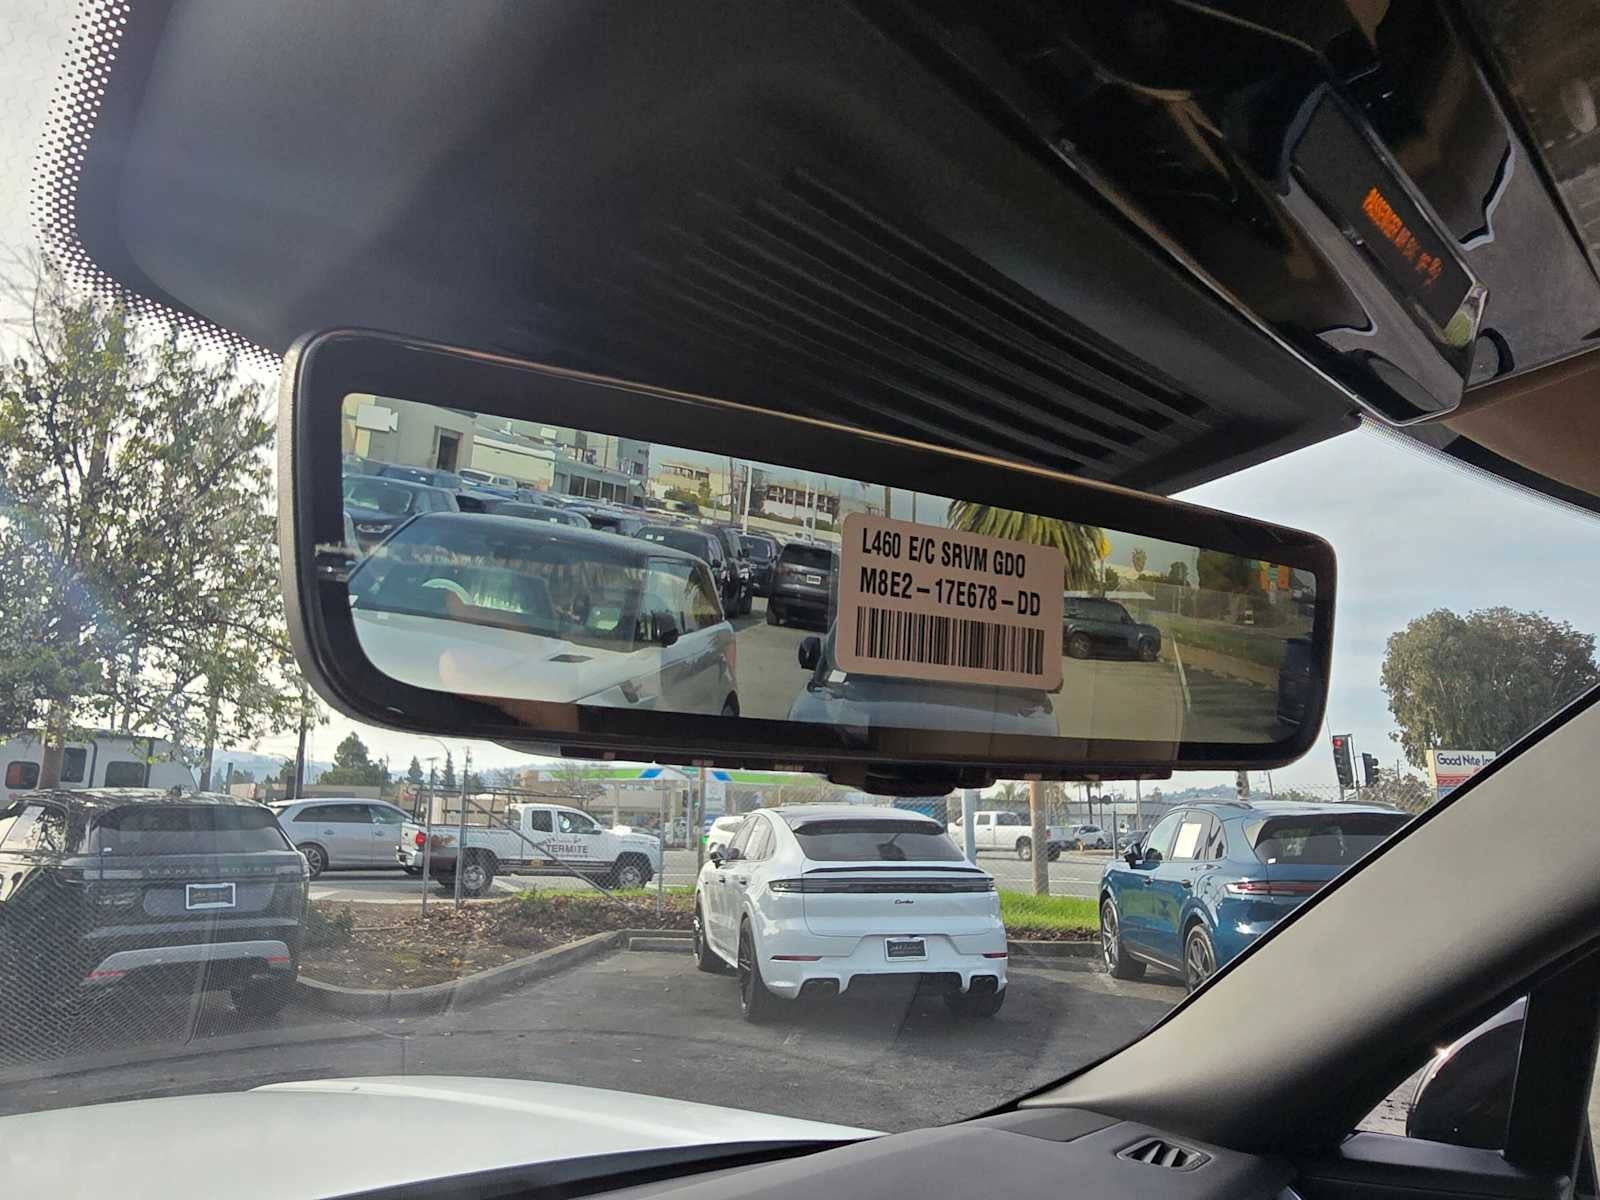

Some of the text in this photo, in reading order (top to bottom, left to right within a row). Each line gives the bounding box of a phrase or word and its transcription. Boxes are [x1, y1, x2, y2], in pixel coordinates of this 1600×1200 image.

[862, 527, 1026, 578] L460 E/C SRVM GDO
[1437, 752, 1461, 766] Good
[546, 844, 589, 854] TERMITE
